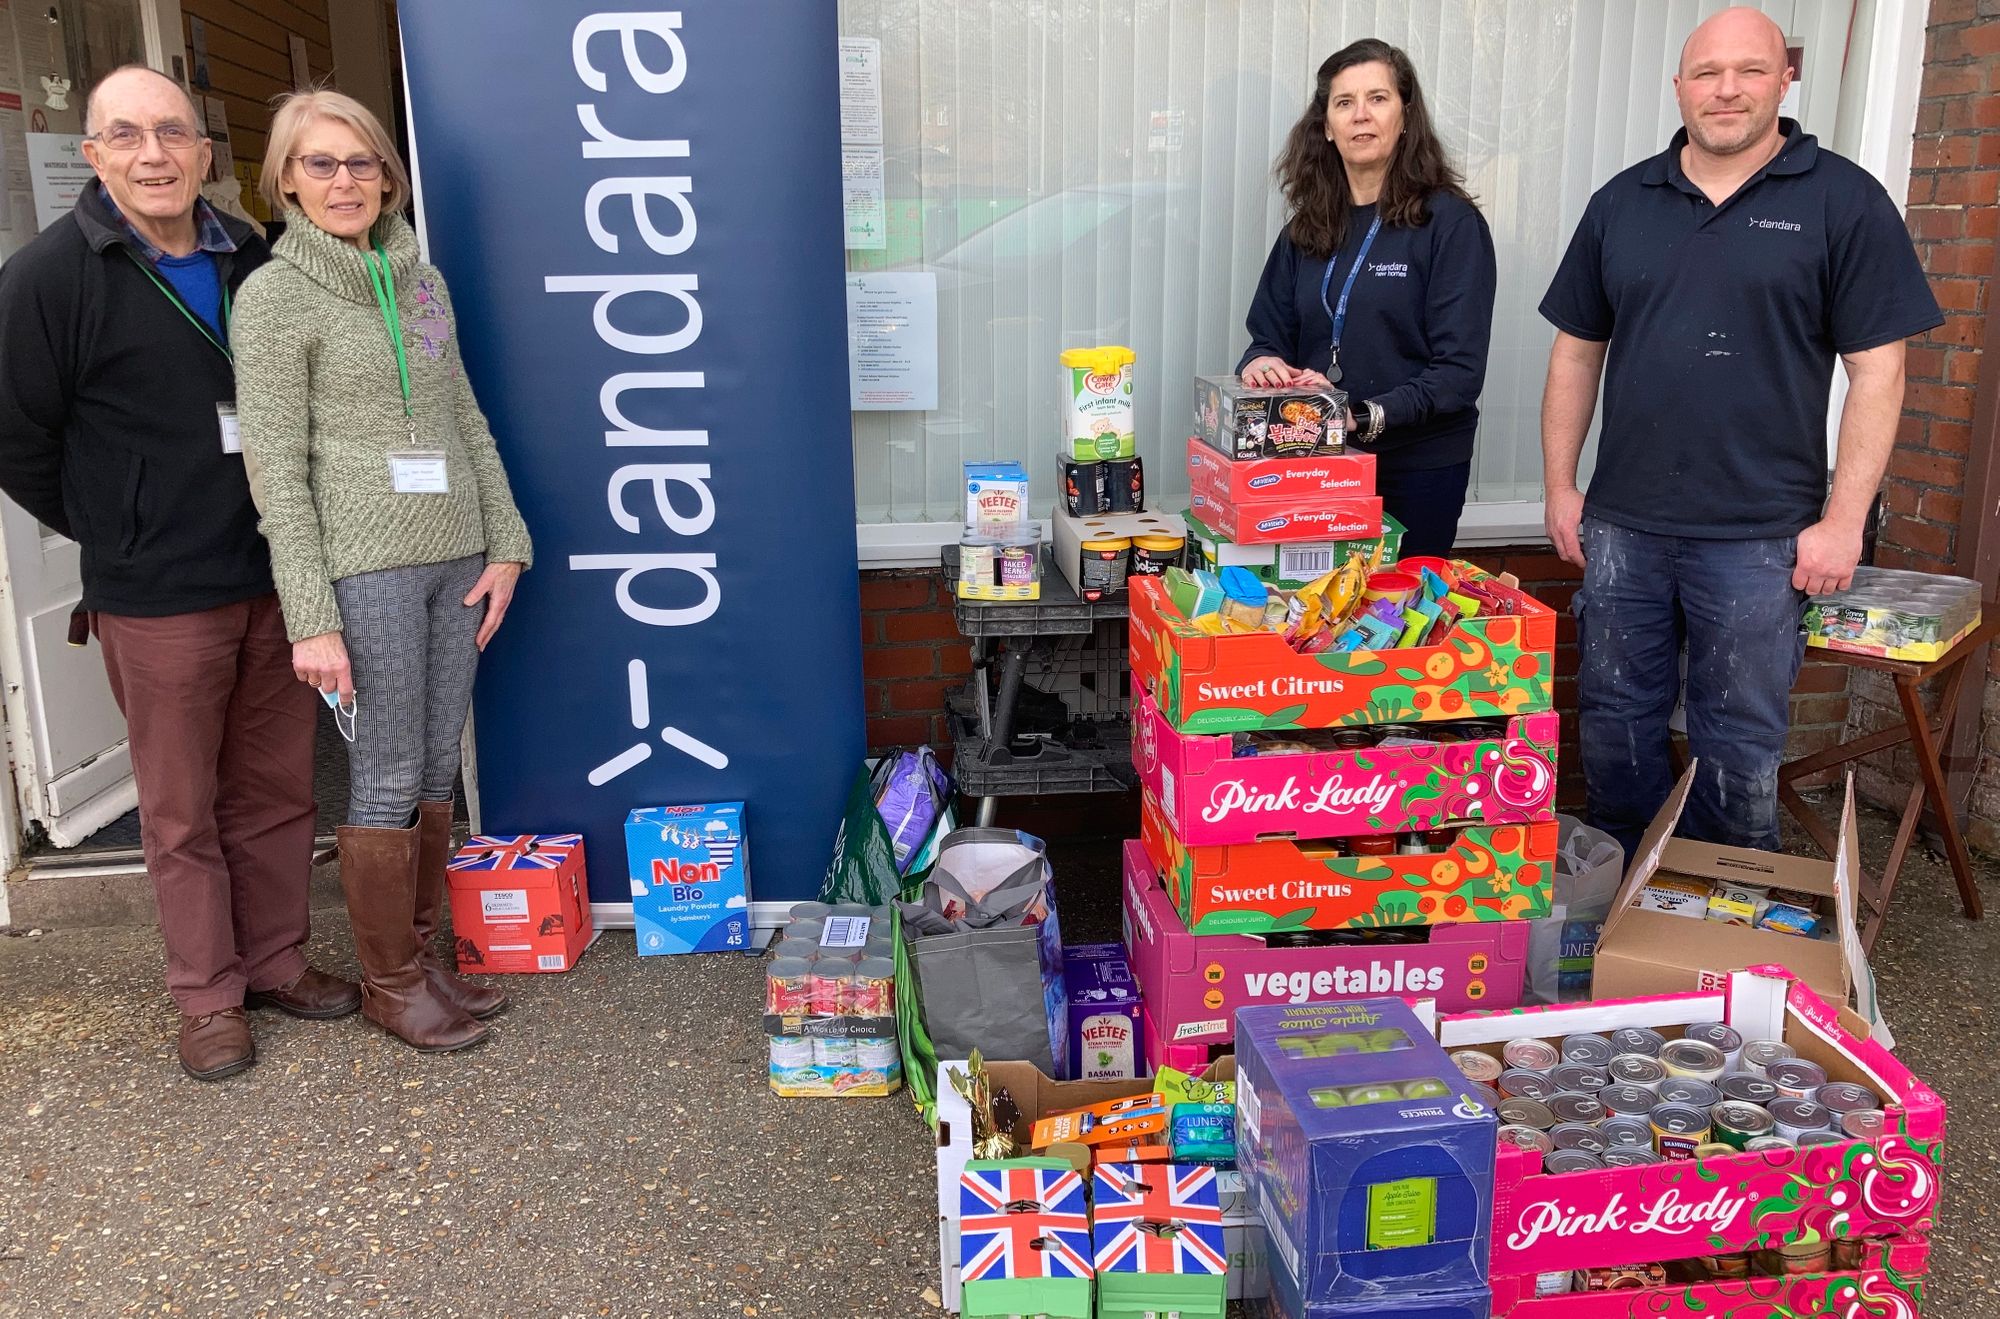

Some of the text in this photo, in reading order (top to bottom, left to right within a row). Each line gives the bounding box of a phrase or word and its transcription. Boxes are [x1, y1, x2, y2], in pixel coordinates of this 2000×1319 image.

[1759, 217, 1802, 232] dandara
[1375, 261, 1408, 272] dandara
[544, 11, 721, 627] dandara
[1094, 382, 1113, 390] Gate
[1078, 399, 1094, 414] First
[1095, 396, 1117, 406] infant
[1117, 398, 1132, 410] milk
[1237, 451, 1258, 459] KOREA
[1286, 468, 1330, 481] Everyday
[1320, 479, 1361, 489] Selection
[979, 496, 1018, 510] VEETEE
[1293, 511, 1337, 524] Everyday
[1327, 522, 1368, 532] Selection
[1003, 560, 1027, 568] BAKED
[1134, 553, 1160, 574] Soba
[1845, 608, 1865, 618] Green
[1845, 614, 1866, 623] Giant
[1198, 675, 1345, 702] Sweet Citrus
[1196, 714, 1258, 725] DELICIOUSLY JUICY
[1201, 774, 1399, 823] Pink Lady
[664, 805, 706, 815] Non
[651, 857, 721, 886] Non
[494, 892, 514, 900] TESCO
[672, 885, 704, 902] Bio
[1211, 879, 1352, 904] Sweet Citrus
[1651, 893, 1689, 903] QUAKER
[485, 902, 492, 912] 6
[658, 901, 720, 913] Laundry Powder
[671, 914, 711, 923] by Sainsbury's
[1208, 915, 1268, 926] DELICIOUSLY JUICY
[726, 934, 743, 946] 45
[1559, 942, 1598, 958] UNEX
[1244, 960, 1445, 1003] vegetables
[1285, 1005, 1367, 1018] FROM CONCENTRATE
[1278, 1012, 1383, 1030] Apple Juice
[1804, 1005, 1845, 1041] Pink Lady
[811, 1025, 837, 1034] WORLD
[850, 1025, 877, 1034] CHOICE
[1082, 1026, 1128, 1041] VEETEE
[1177, 1020, 1226, 1037] freshtime
[1088, 1070, 1124, 1078] BASMATI
[1400, 1109, 1446, 1119] PRINCES
[1052, 1115, 1063, 1137] BLADE
[1060, 1116, 1071, 1139] RAZOR
[1186, 1116, 1224, 1127] LUNEX
[1669, 1150, 1690, 1159] Beef
[1507, 1186, 1749, 1250] Pink Lady
